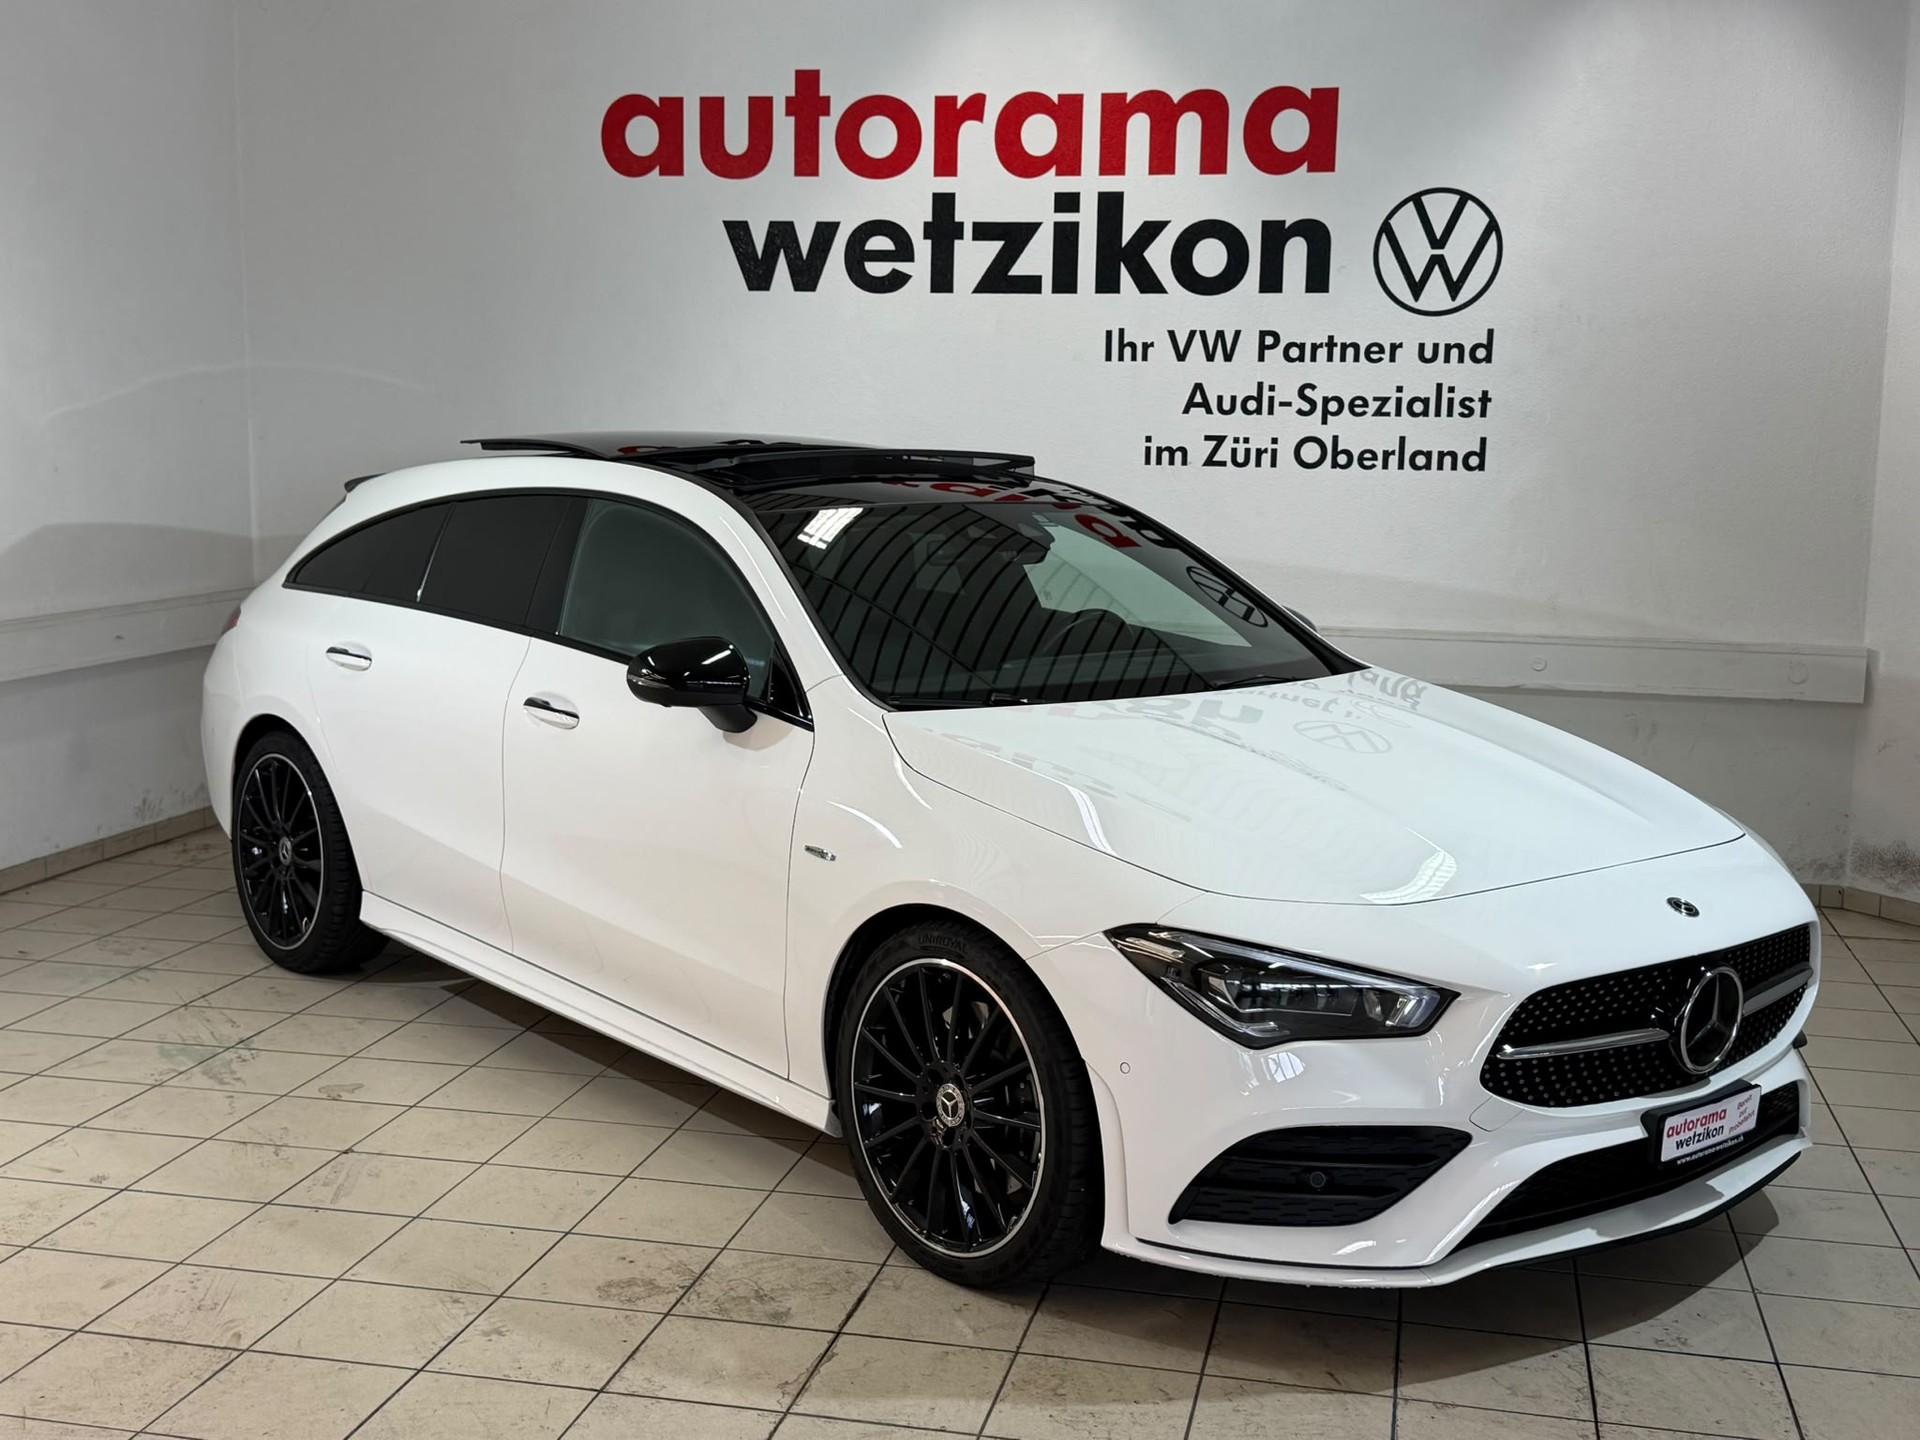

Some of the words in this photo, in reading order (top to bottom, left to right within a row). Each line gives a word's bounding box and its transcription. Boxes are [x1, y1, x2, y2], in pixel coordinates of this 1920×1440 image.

[601, 68, 1340, 180] autorama
[721, 191, 1333, 297] wetzikon
[1104, 327, 1155, 363] Ihr
[1166, 329, 1242, 363] VW
[1256, 329, 1404, 364] Partner
[1417, 328, 1495, 365] und
[1181, 381, 1493, 426] Audi-Spezialist
[1144, 435, 1188, 467] im
[1201, 434, 1279, 469] Züri
[1293, 434, 1488, 472] Oberland
[1666, 1108, 1727, 1138] autorama
[1676, 1125, 1724, 1150] wetzikon
